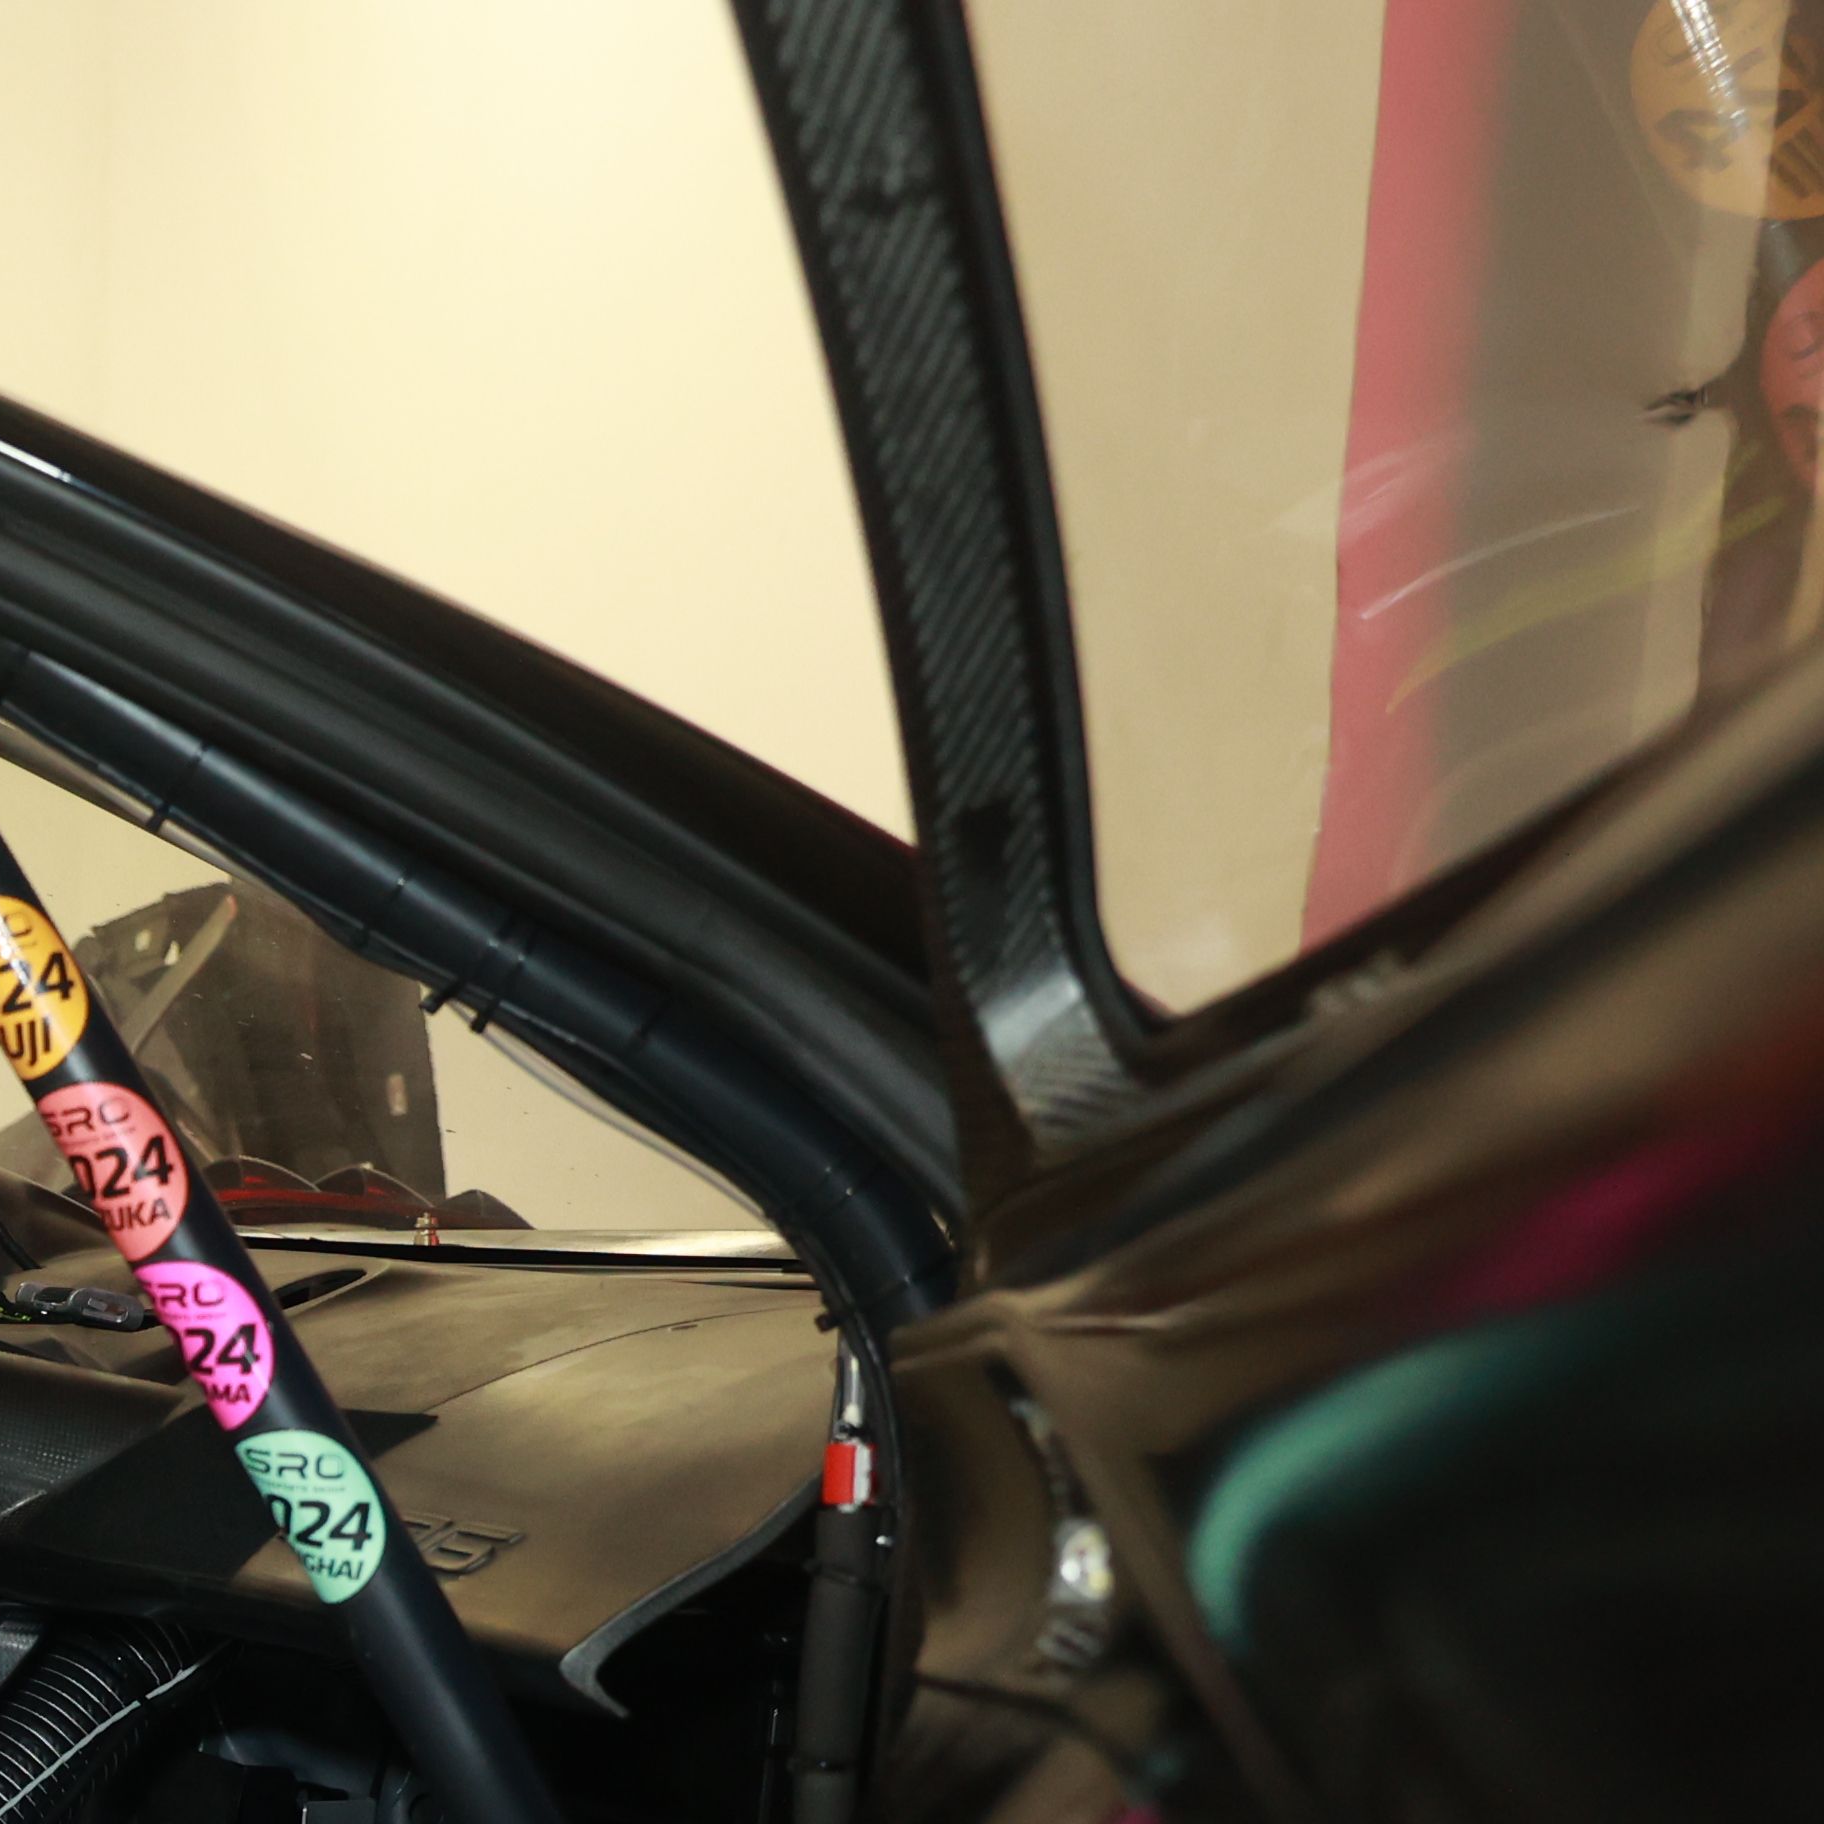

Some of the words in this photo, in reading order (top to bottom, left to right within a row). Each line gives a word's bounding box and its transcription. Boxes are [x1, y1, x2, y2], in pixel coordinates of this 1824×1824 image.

[69, 1134, 174, 1199] 024
[170, 1322, 262, 1377] 24
[245, 1448, 346, 1480] SRO
[267, 1492, 373, 1552] 024
[302, 1553, 365, 1581] GHAI
